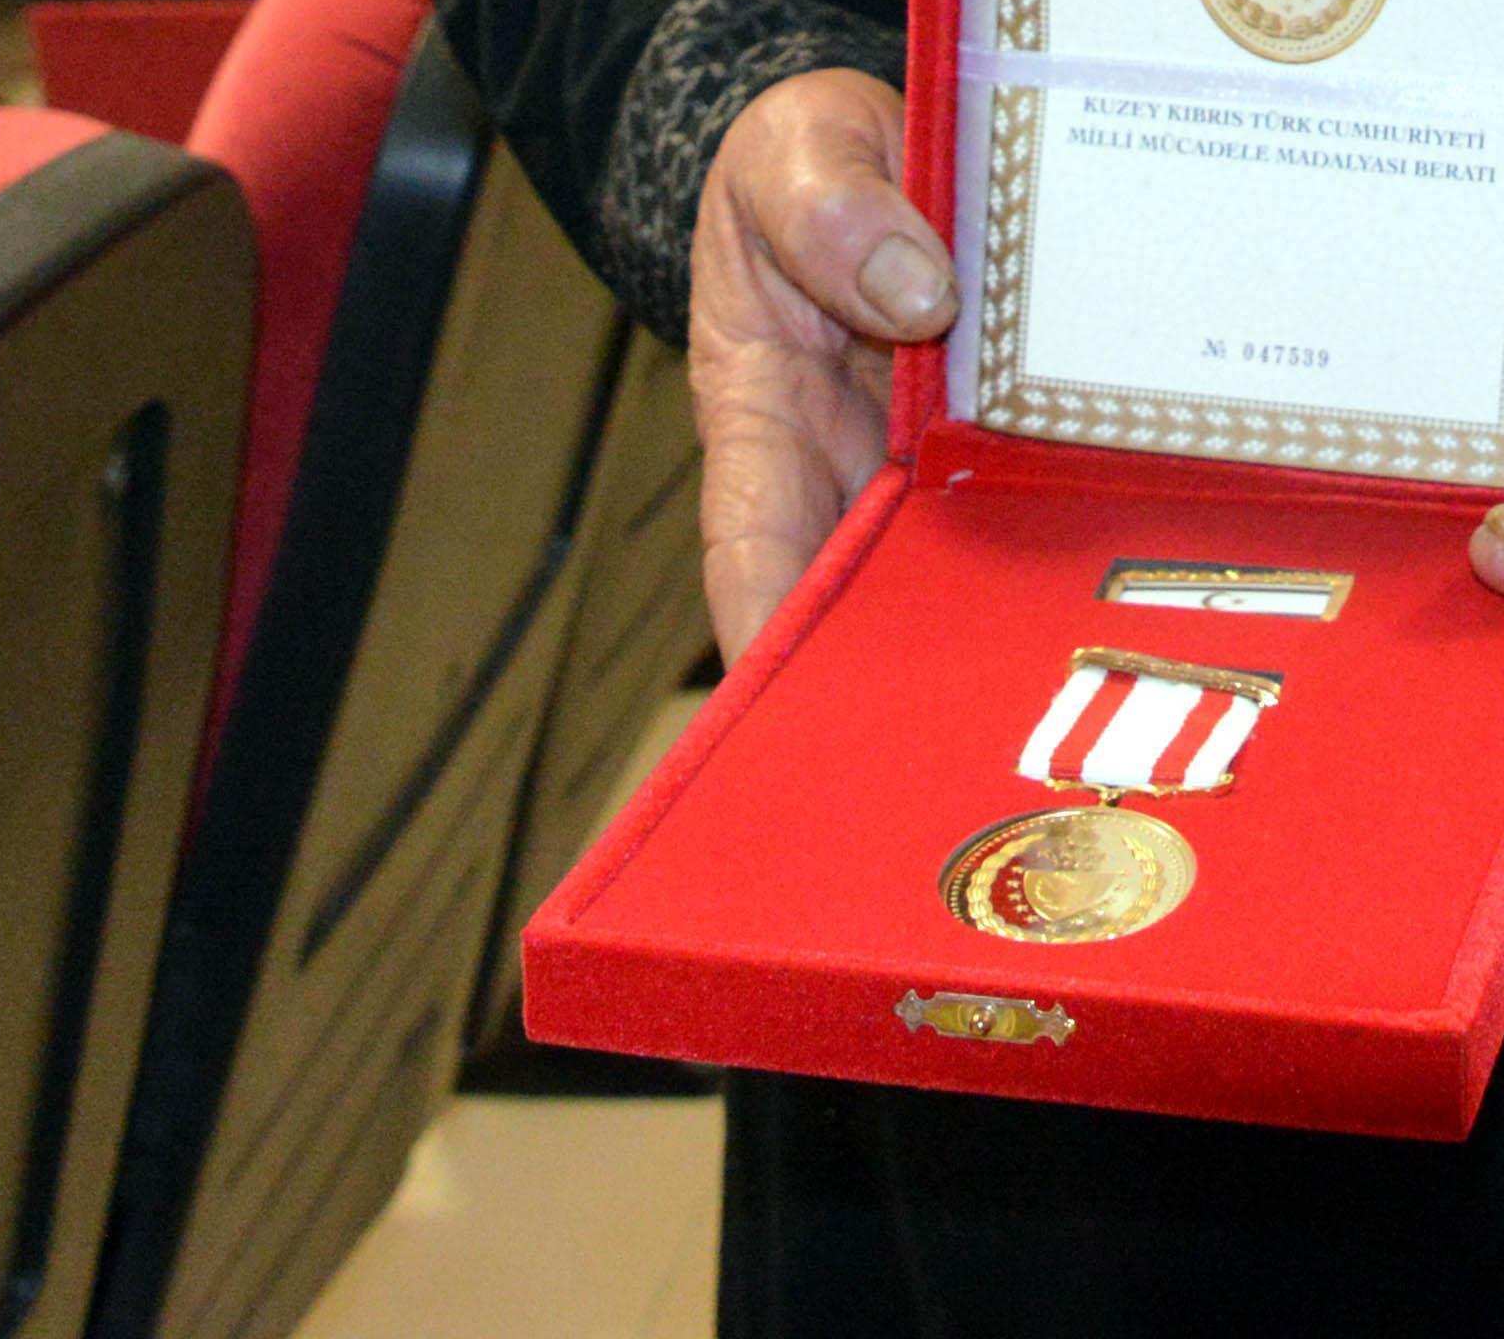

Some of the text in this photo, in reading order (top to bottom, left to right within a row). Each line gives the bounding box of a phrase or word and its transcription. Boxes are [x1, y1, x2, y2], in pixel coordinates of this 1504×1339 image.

[1083, 96, 1486, 150] KUZEY KIBRIS TÜRK CUMHURİYETİ
[1067, 126, 1496, 183] MİLLİ MÜCADELE MADALYASI BERATI
[1242, 342, 1330, 368] 047539
